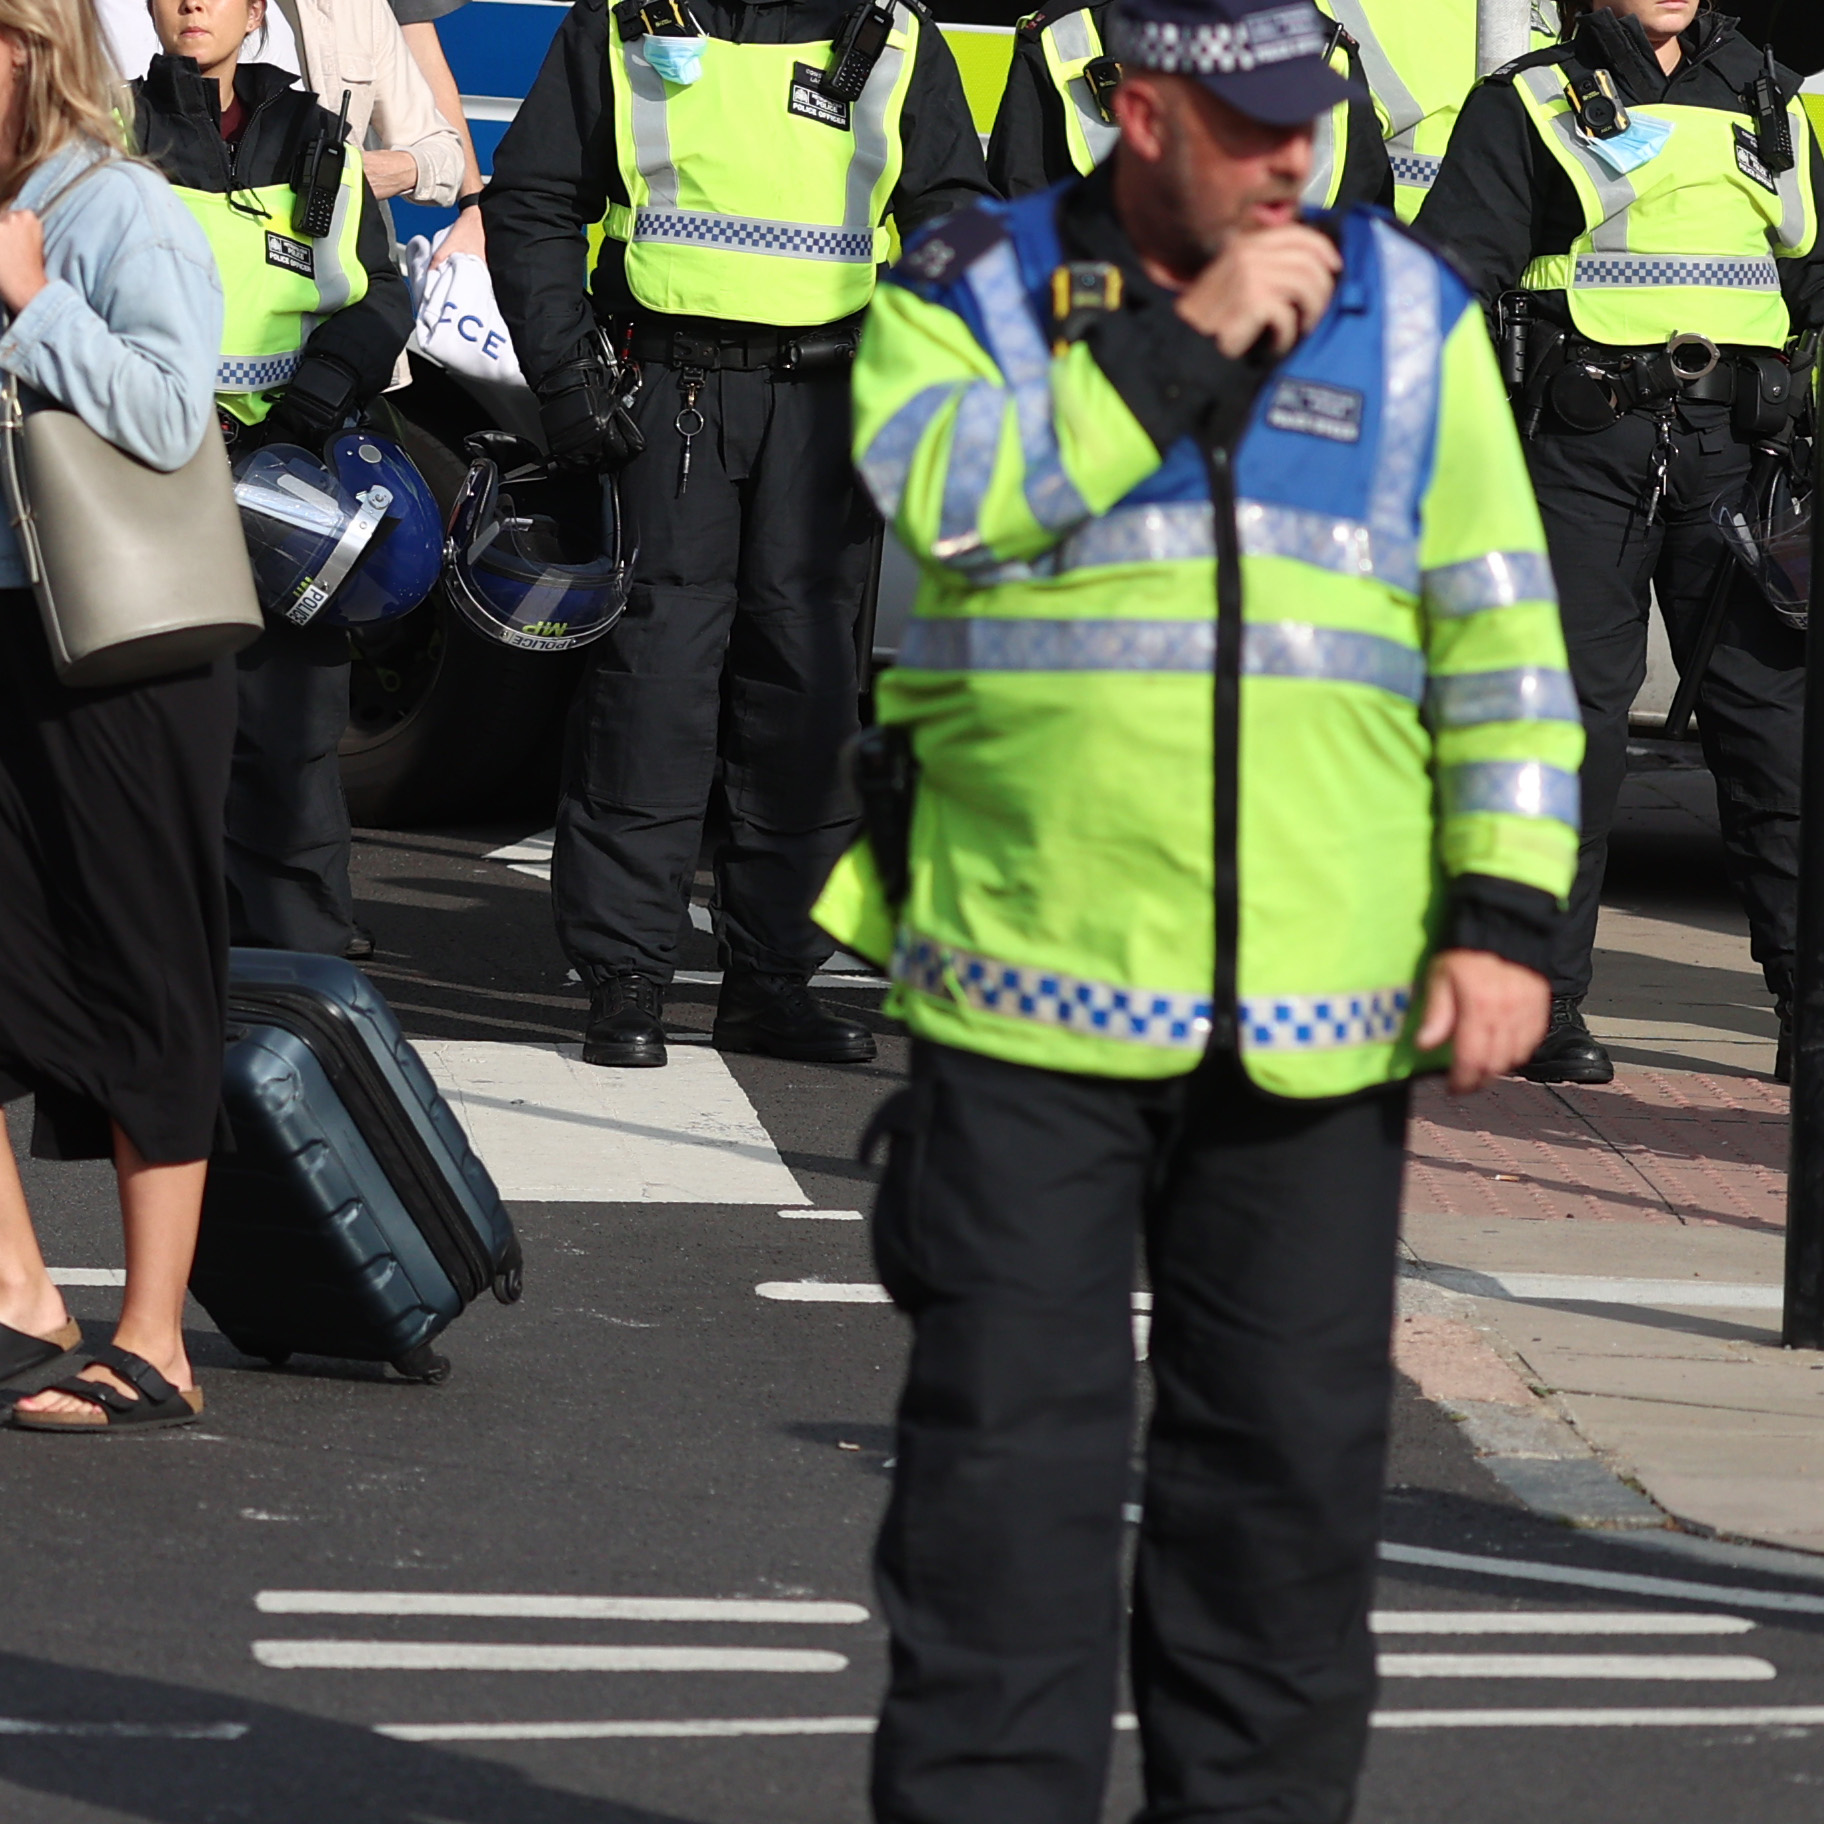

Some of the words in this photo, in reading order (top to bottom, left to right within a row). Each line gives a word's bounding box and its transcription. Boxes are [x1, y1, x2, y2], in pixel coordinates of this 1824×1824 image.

[792, 102, 817, 116] POLICE
[817, 110, 847, 126] OFFICER
[512, 634, 569, 651] POLICE
